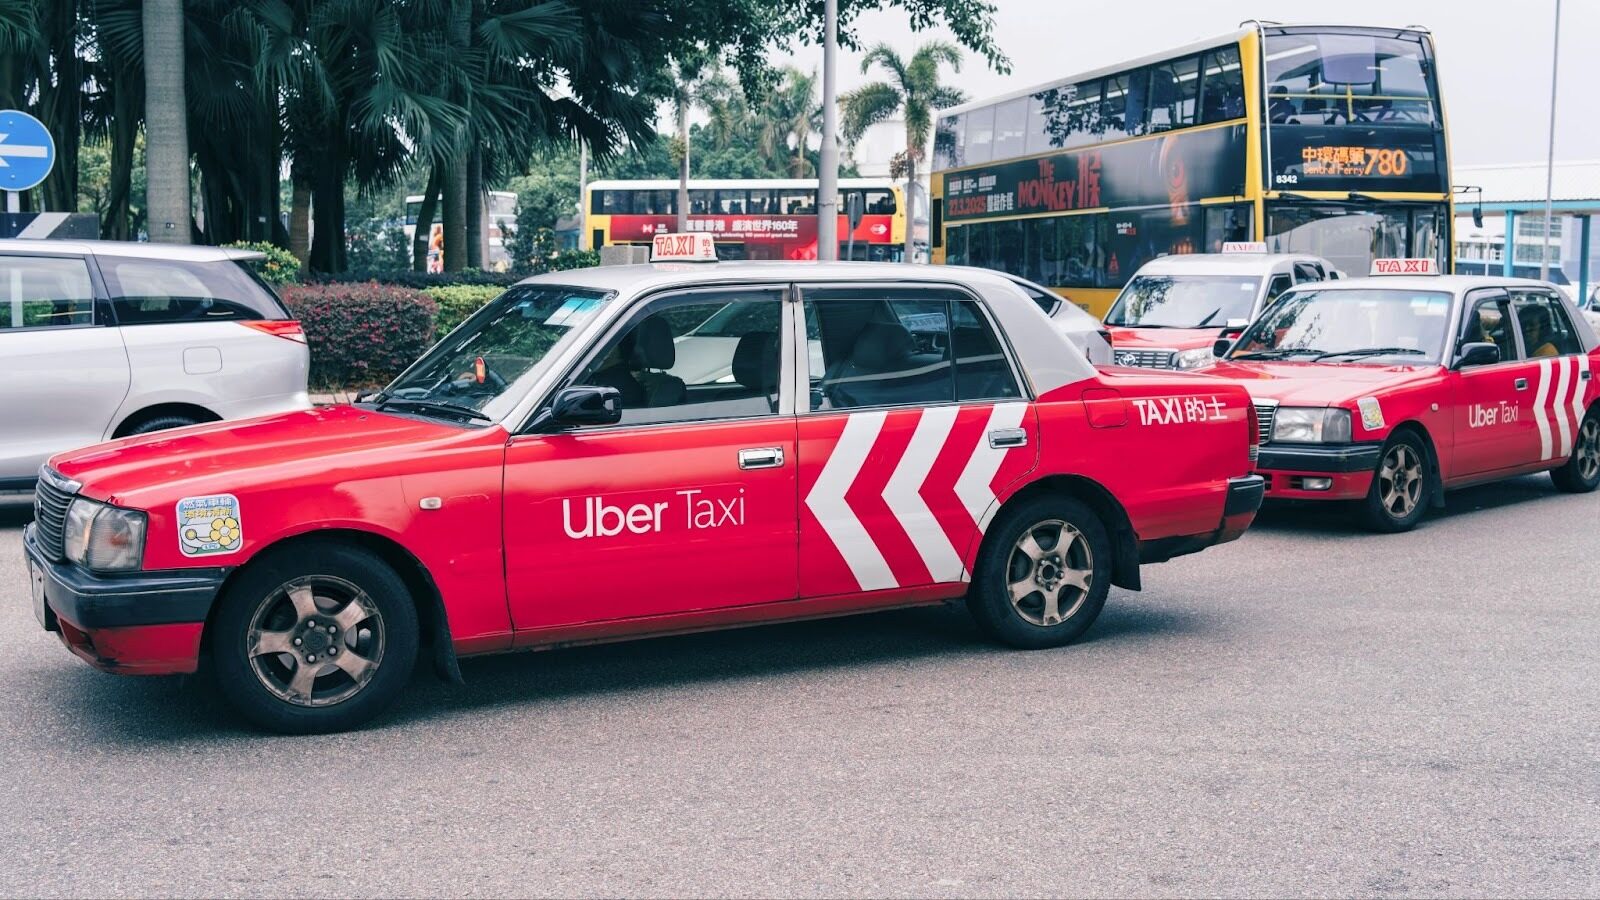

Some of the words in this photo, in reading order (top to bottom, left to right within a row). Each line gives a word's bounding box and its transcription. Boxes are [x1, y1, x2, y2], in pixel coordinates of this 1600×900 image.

[1302, 146, 1366, 164] 中環碼頭
[1365, 148, 1407, 176] 780
[1037, 159, 1056, 182] THE
[1276, 174, 1298, 184] 8342
[1338, 163, 1366, 177] Ferry
[1018, 180, 1076, 211] MONKEY
[656, 235, 695, 256] TAXI
[702, 238, 712, 258] 的士
[1226, 243, 1247, 252] TAXI
[1375, 260, 1429, 273] TAXI
[1468, 403, 1499, 429] Uber
[1499, 400, 1519, 424] Taxi
[562, 496, 669, 540] Uber
[675, 488, 746, 530] Taxi
